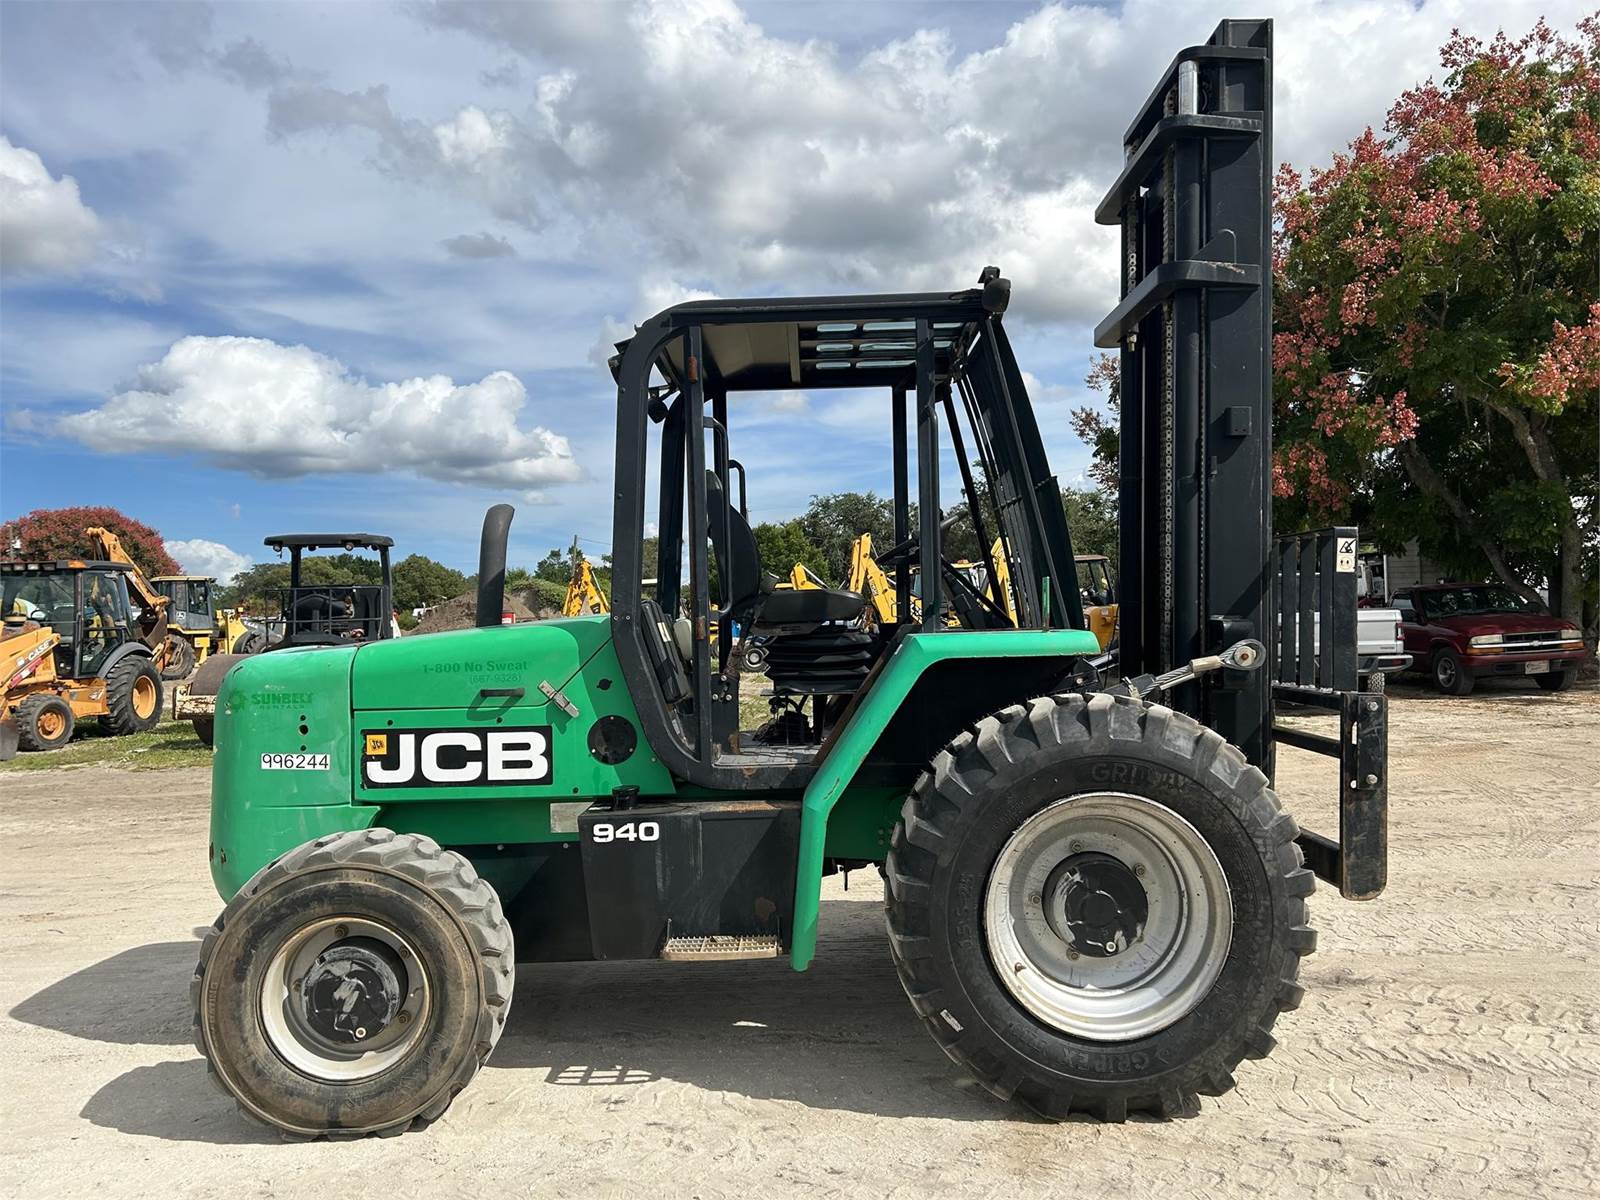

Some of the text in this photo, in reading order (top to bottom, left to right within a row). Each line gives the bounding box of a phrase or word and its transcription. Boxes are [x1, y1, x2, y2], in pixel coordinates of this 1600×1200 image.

[423, 660, 529, 674] 1-800 No Sweat
[251, 692, 314, 705] SUNBELT
[262, 753, 329, 769] 996244
[366, 731, 549, 784] JCB
[592, 821, 660, 843] 940
